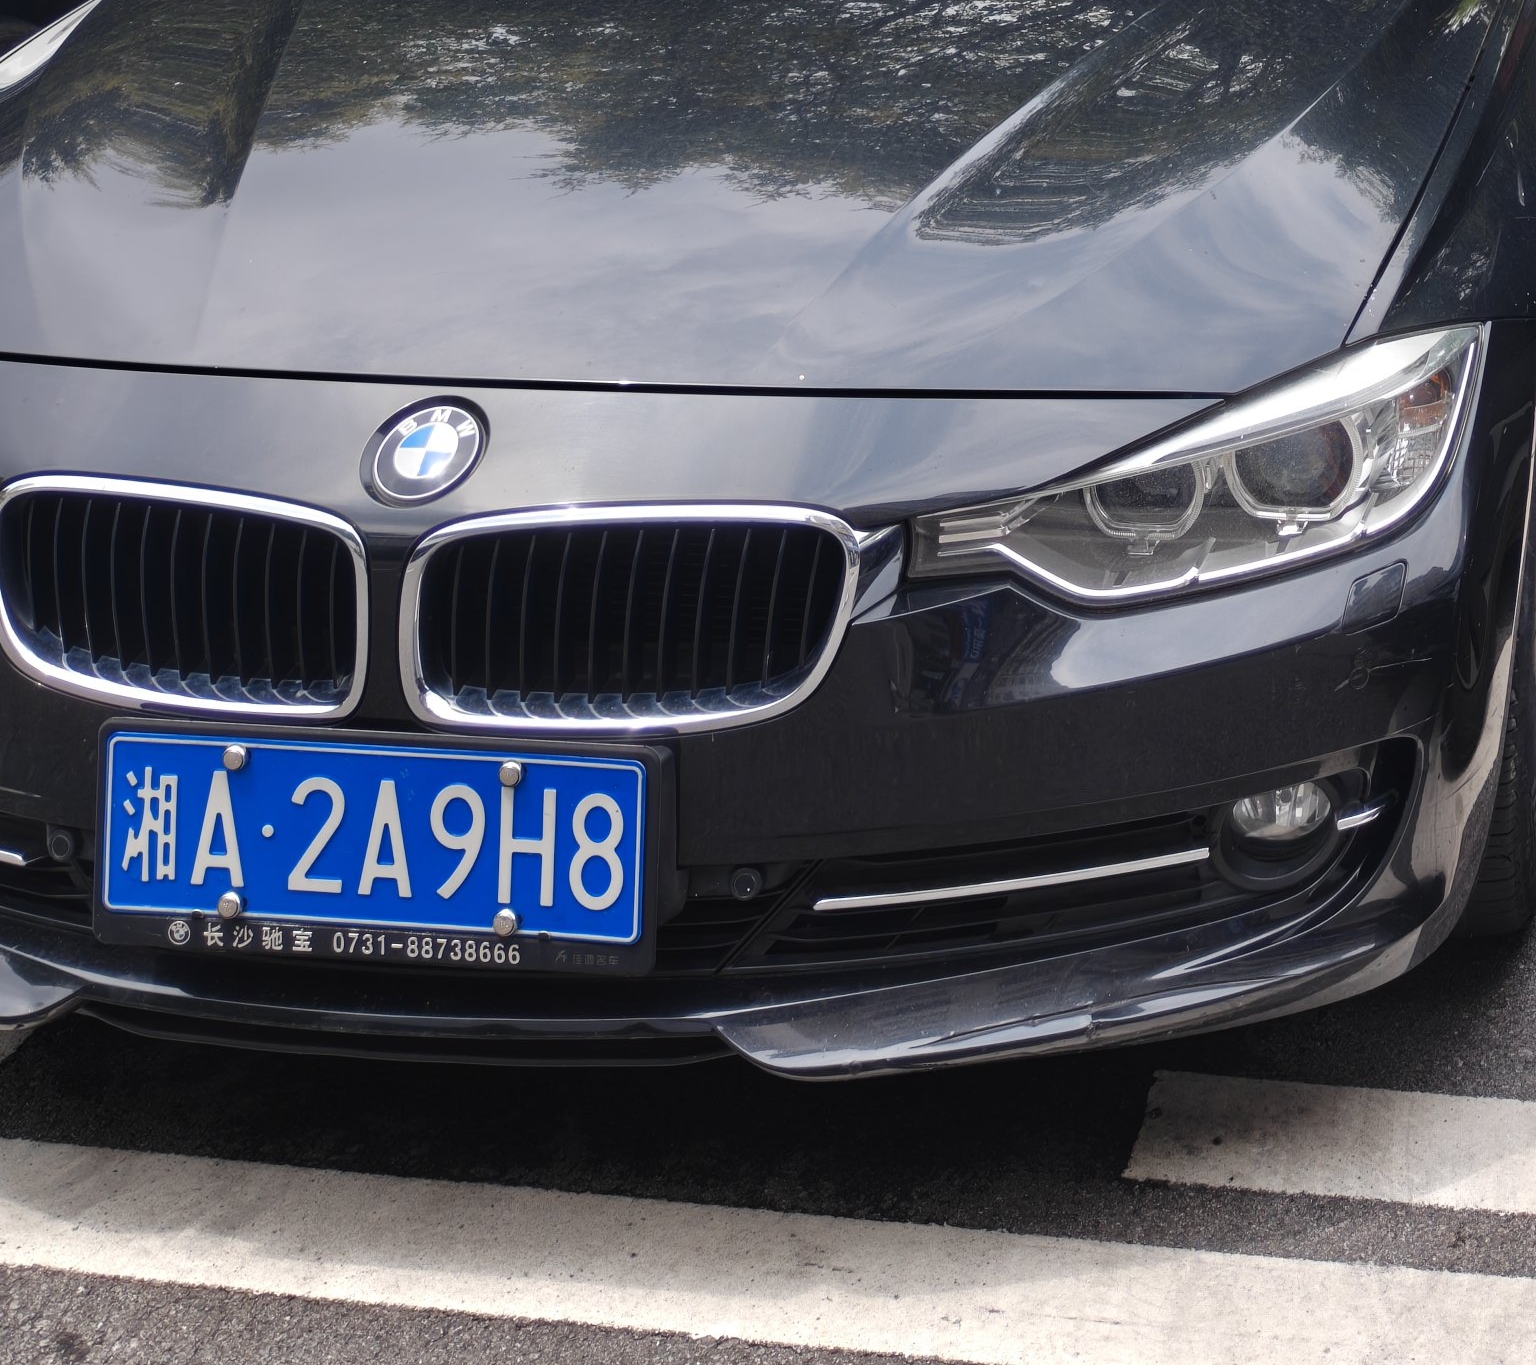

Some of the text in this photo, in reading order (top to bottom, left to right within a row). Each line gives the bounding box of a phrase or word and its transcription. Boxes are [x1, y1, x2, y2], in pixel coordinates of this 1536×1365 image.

[397, 408, 476, 439] BMW
[121, 765, 625, 911] 湘A·2A9H8
[203, 922, 521, 965] 长沙驰宝 0731-88738666
